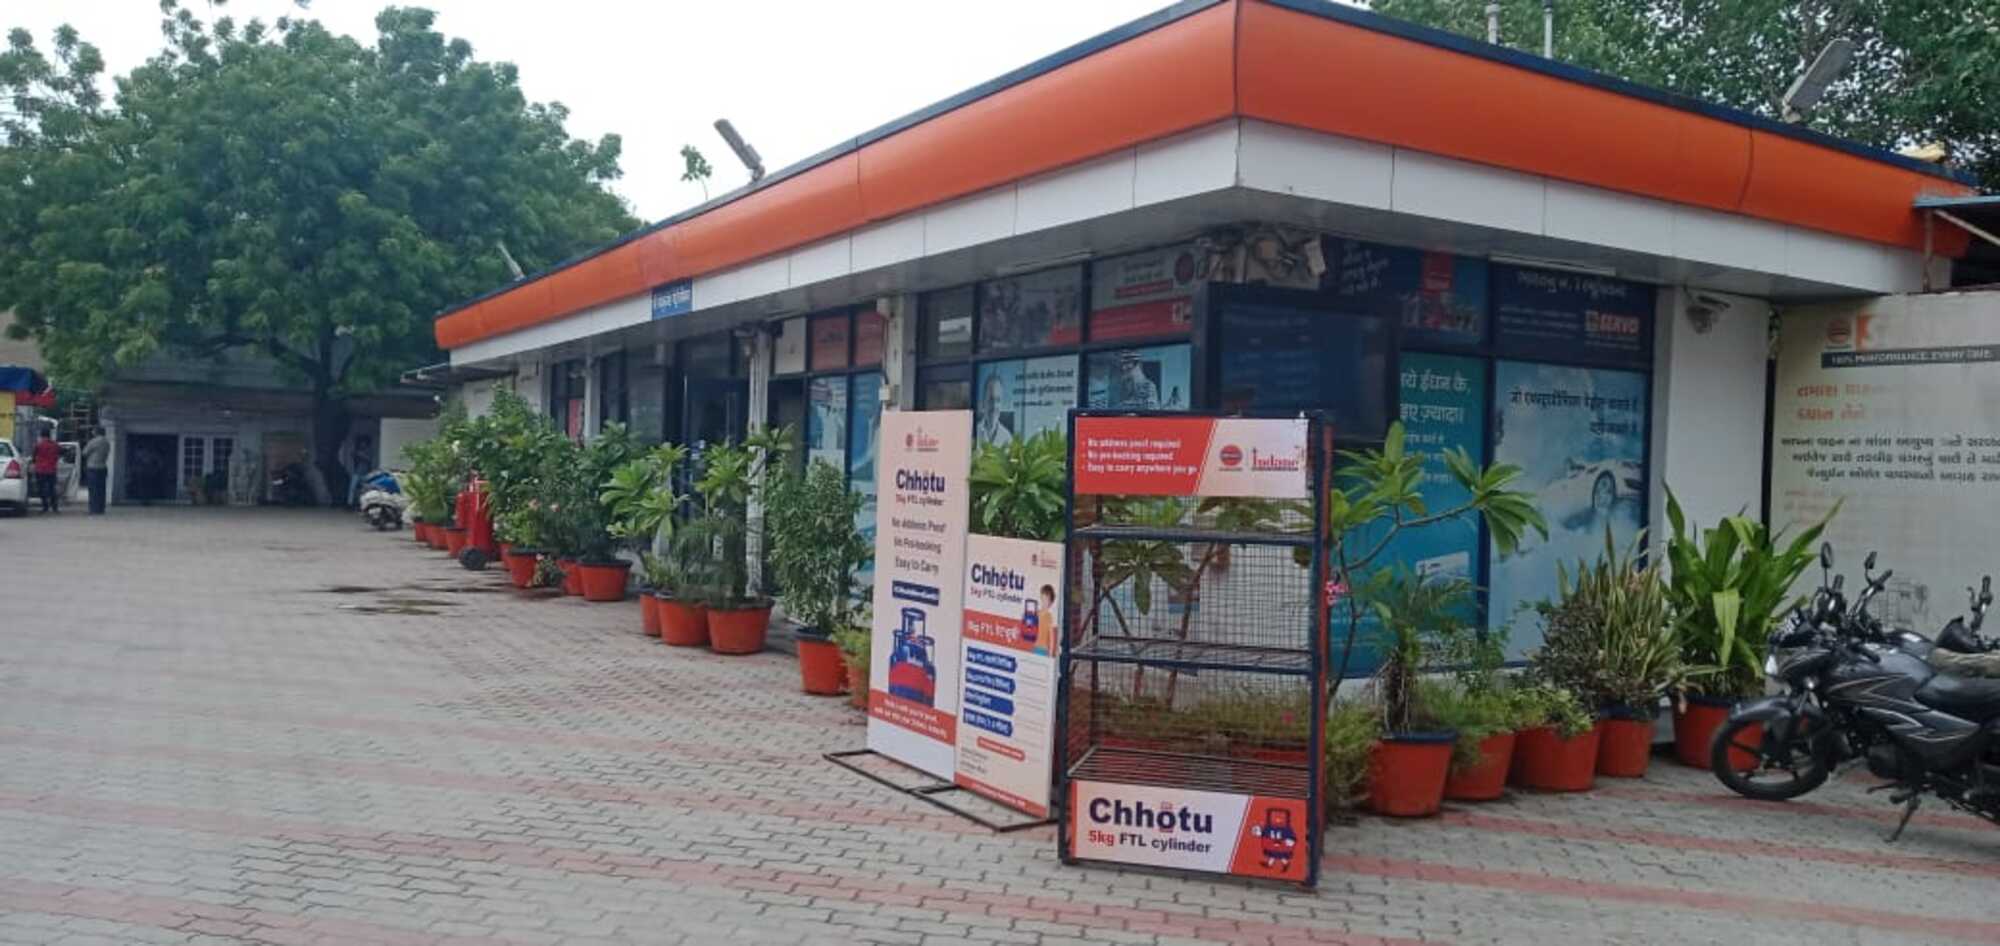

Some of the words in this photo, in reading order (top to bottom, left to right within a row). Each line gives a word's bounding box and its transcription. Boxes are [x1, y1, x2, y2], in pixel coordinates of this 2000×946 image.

[1601, 314, 1640, 334] SERVO
[1100, 439, 1128, 448] address
[1129, 440, 1149, 449] proof
[1150, 439, 1181, 449] required
[1142, 452, 1173, 462] required
[1088, 463, 1105, 474] Easy
[1106, 465, 1113, 473] to
[1114, 465, 1134, 475] carry
[1136, 464, 1171, 474] anywhere
[1173, 466, 1188, 475] you
[1189, 466, 1197, 475] go
[896, 469, 945, 492] Chhotu
[920, 496, 943, 506] cylinder
[892, 517, 900, 527] No
[902, 518, 927, 530] Address
[928, 520, 946, 532] Proof
[903, 538, 942, 554] Pre-booking
[895, 556, 911, 571] Easy
[912, 559, 919, 570] to
[921, 559, 938, 575] Carry
[972, 563, 1025, 591] Chhotu
[996, 592, 1023, 603] cylinder
[1089, 797, 1213, 834] Chhotu
[1088, 829, 1115, 846] 5kg
[1119, 832, 1147, 847] FTL
[1151, 836, 1211, 852] cylinder
